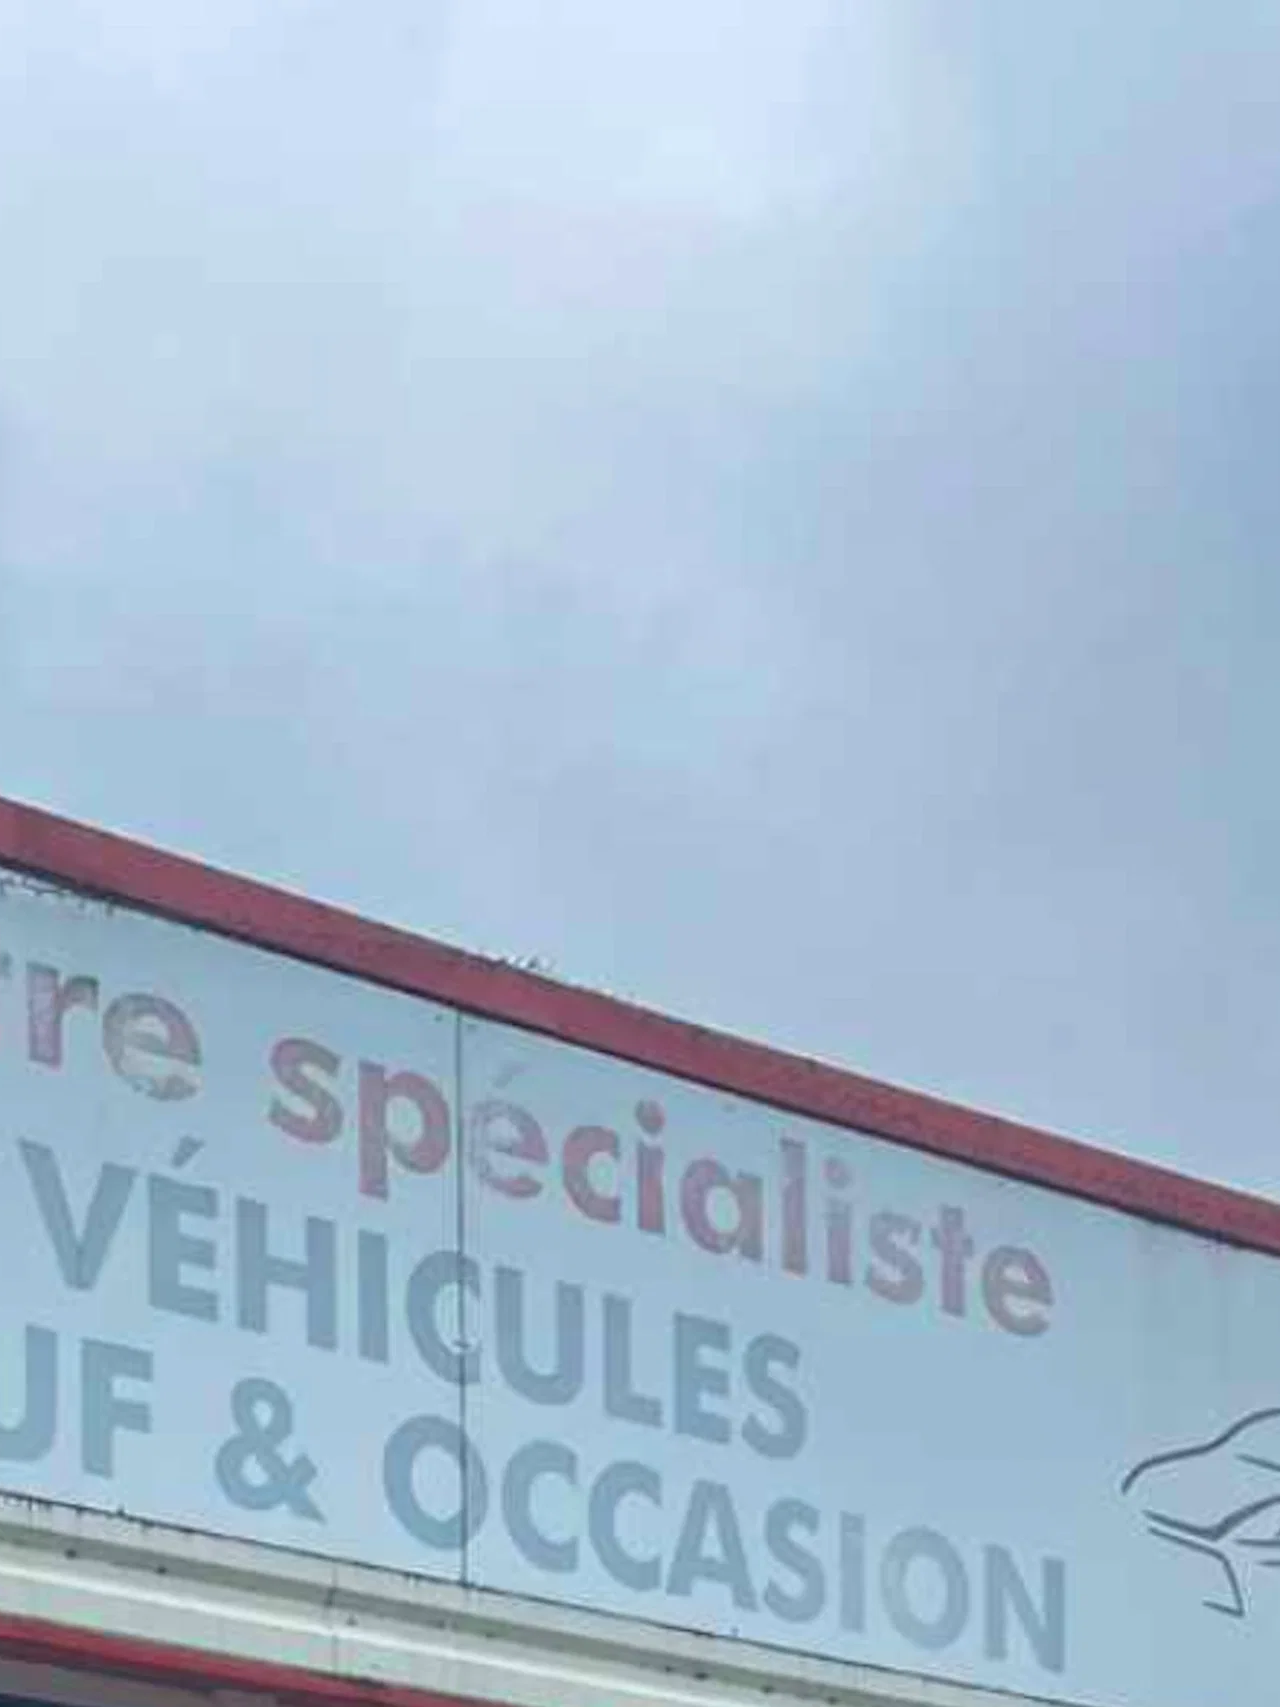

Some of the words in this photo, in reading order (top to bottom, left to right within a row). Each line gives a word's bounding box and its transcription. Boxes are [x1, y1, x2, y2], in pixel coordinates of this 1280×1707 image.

[18, 1136, 807, 1460] VÉHICULES
[267, 1036, 1056, 1338] spécialiste
[215, 1377, 325, 1524] &
[383, 1415, 1066, 1673] OCCASION
